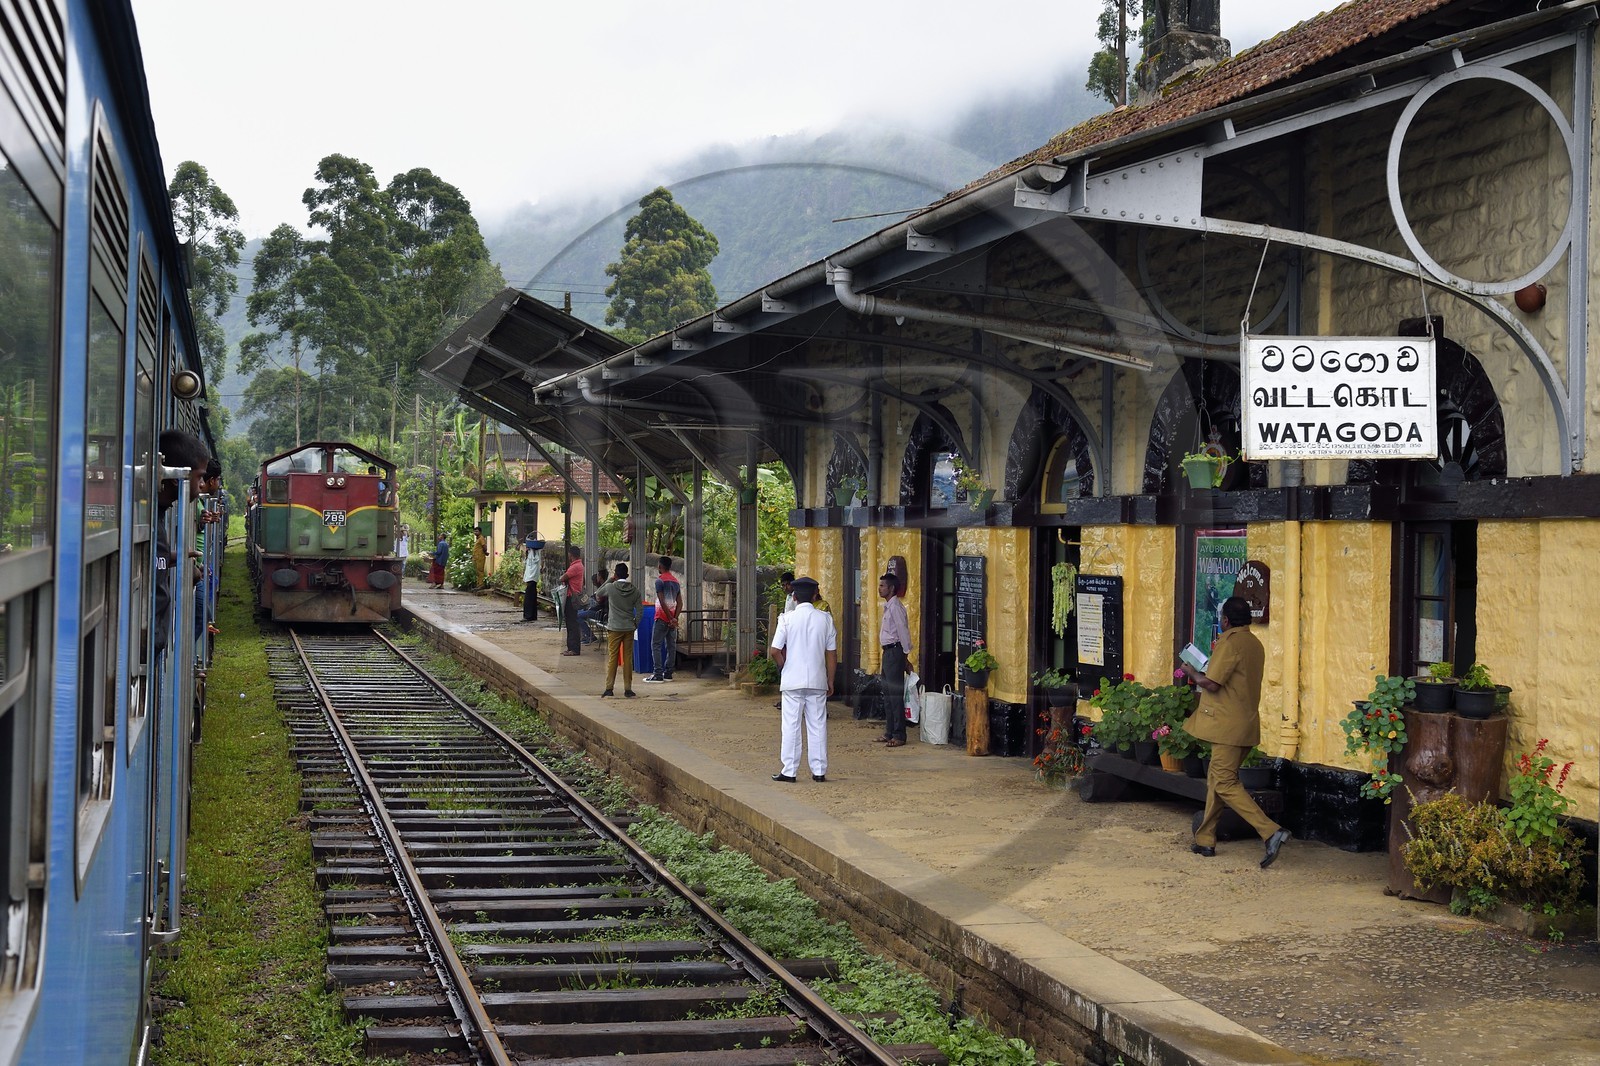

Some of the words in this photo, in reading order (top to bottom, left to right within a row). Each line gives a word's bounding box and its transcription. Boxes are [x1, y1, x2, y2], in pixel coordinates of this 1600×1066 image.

[1261, 345, 1420, 373] වටගොඩ
[1253, 383, 1428, 408] வட்டகொட
[1258, 422, 1423, 443] WATAGODA
[324, 514, 345, 522] 789
[1199, 544, 1245, 554] AYUBOWAN
[1236, 562, 1265, 587] Welcome
